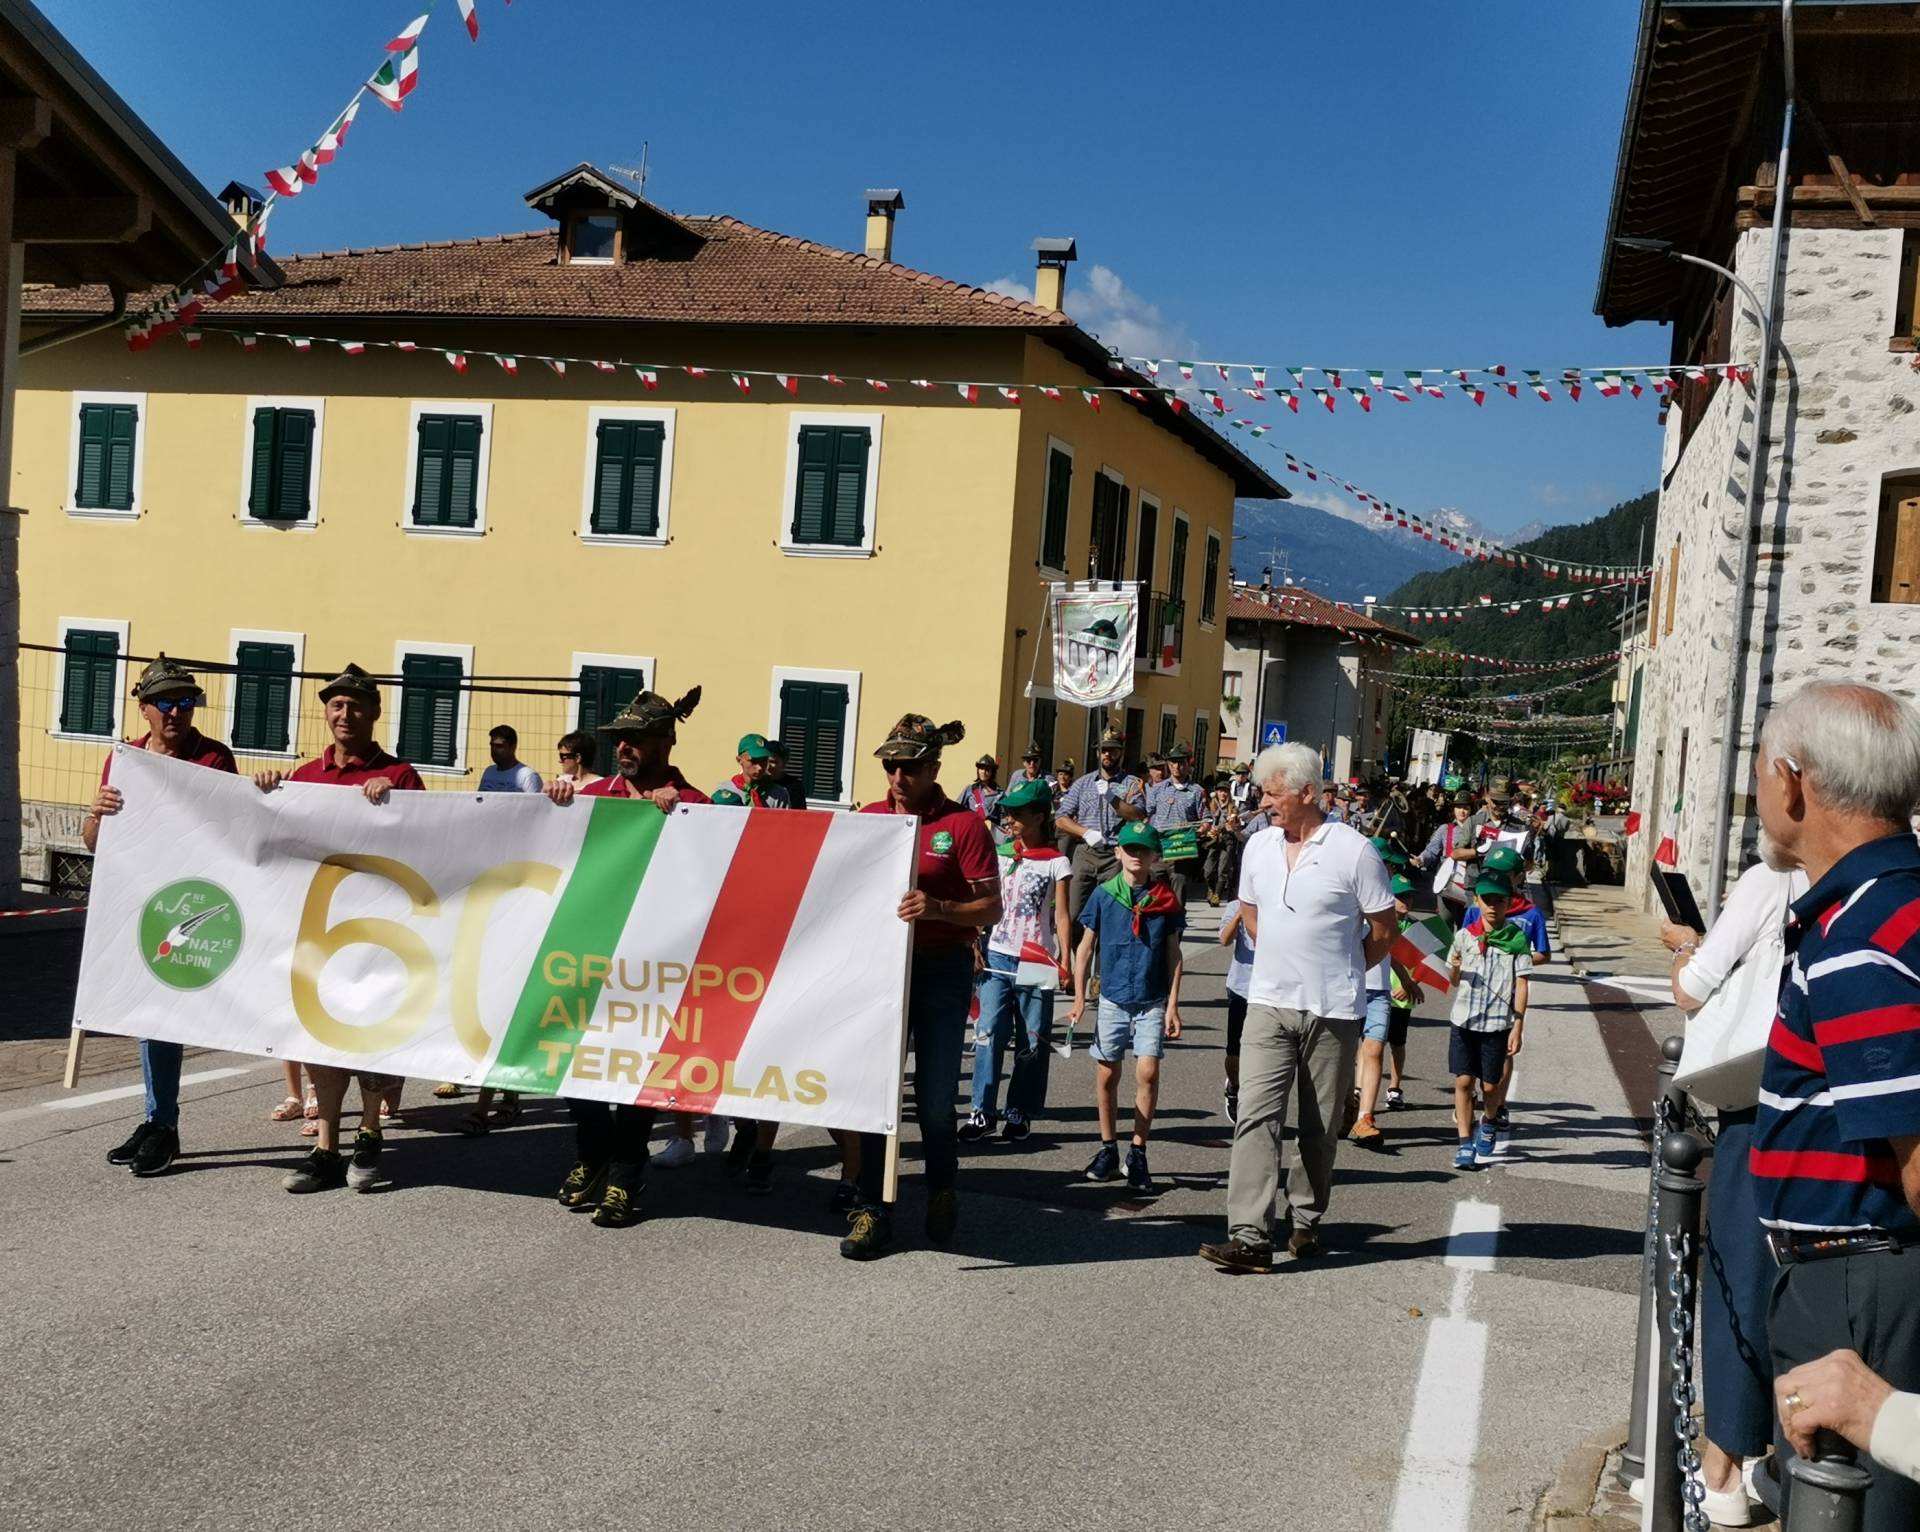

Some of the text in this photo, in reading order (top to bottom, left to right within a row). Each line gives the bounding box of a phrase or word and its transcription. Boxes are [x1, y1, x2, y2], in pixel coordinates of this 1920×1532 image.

[170, 951, 212, 969] ALPINI
[543, 951, 765, 1003] GRUPPO
[538, 995, 704, 1044] ALPINI
[537, 1040, 828, 1106] TERZOLAS
